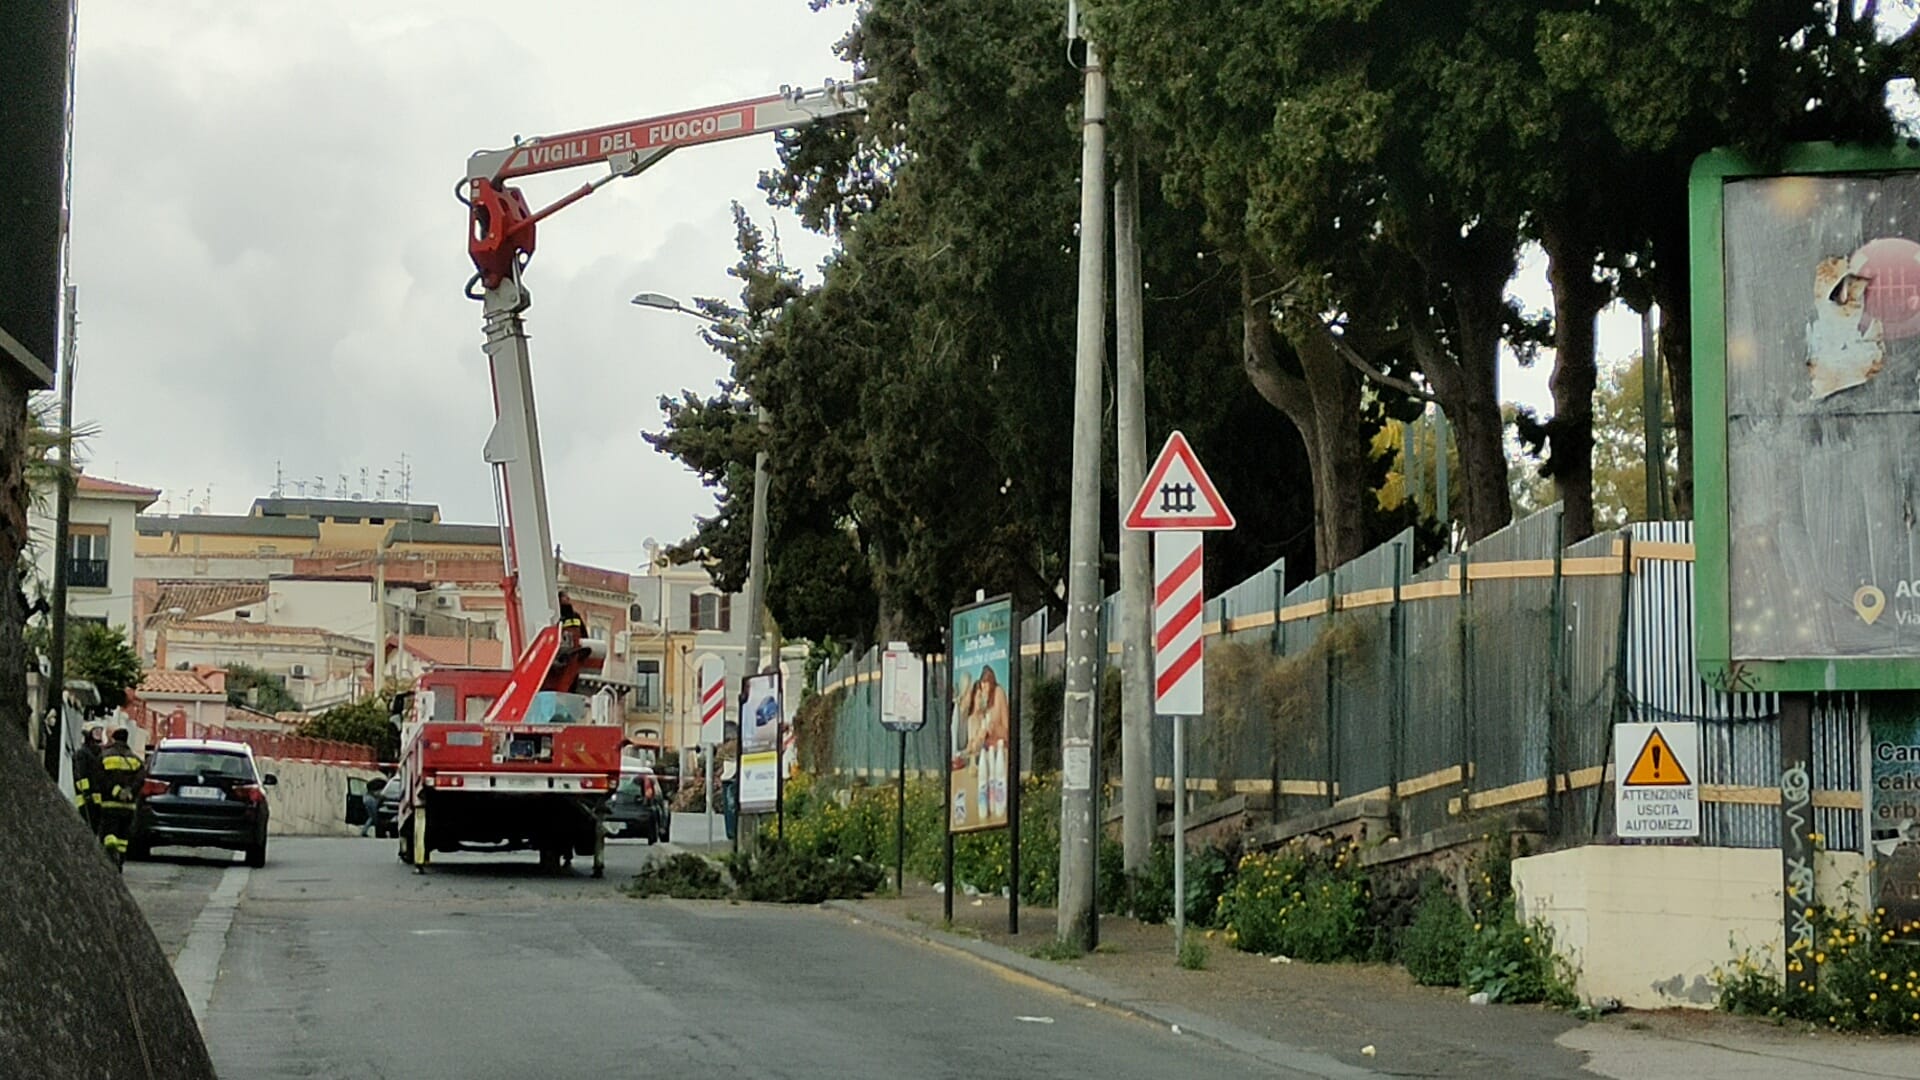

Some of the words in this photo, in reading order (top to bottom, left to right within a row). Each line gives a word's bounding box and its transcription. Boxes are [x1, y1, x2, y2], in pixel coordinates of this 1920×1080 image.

[532, 140, 588, 165] VIGILI
[600, 131, 636, 155] DEL
[649, 117, 716, 144] FUOCO
[1622, 789, 1694, 800] ATTENZIONE
[1637, 804, 1679, 816] USCITA
[1878, 800, 1920, 819] erb
[1625, 819, 1693, 831] AUTOMEZZI
